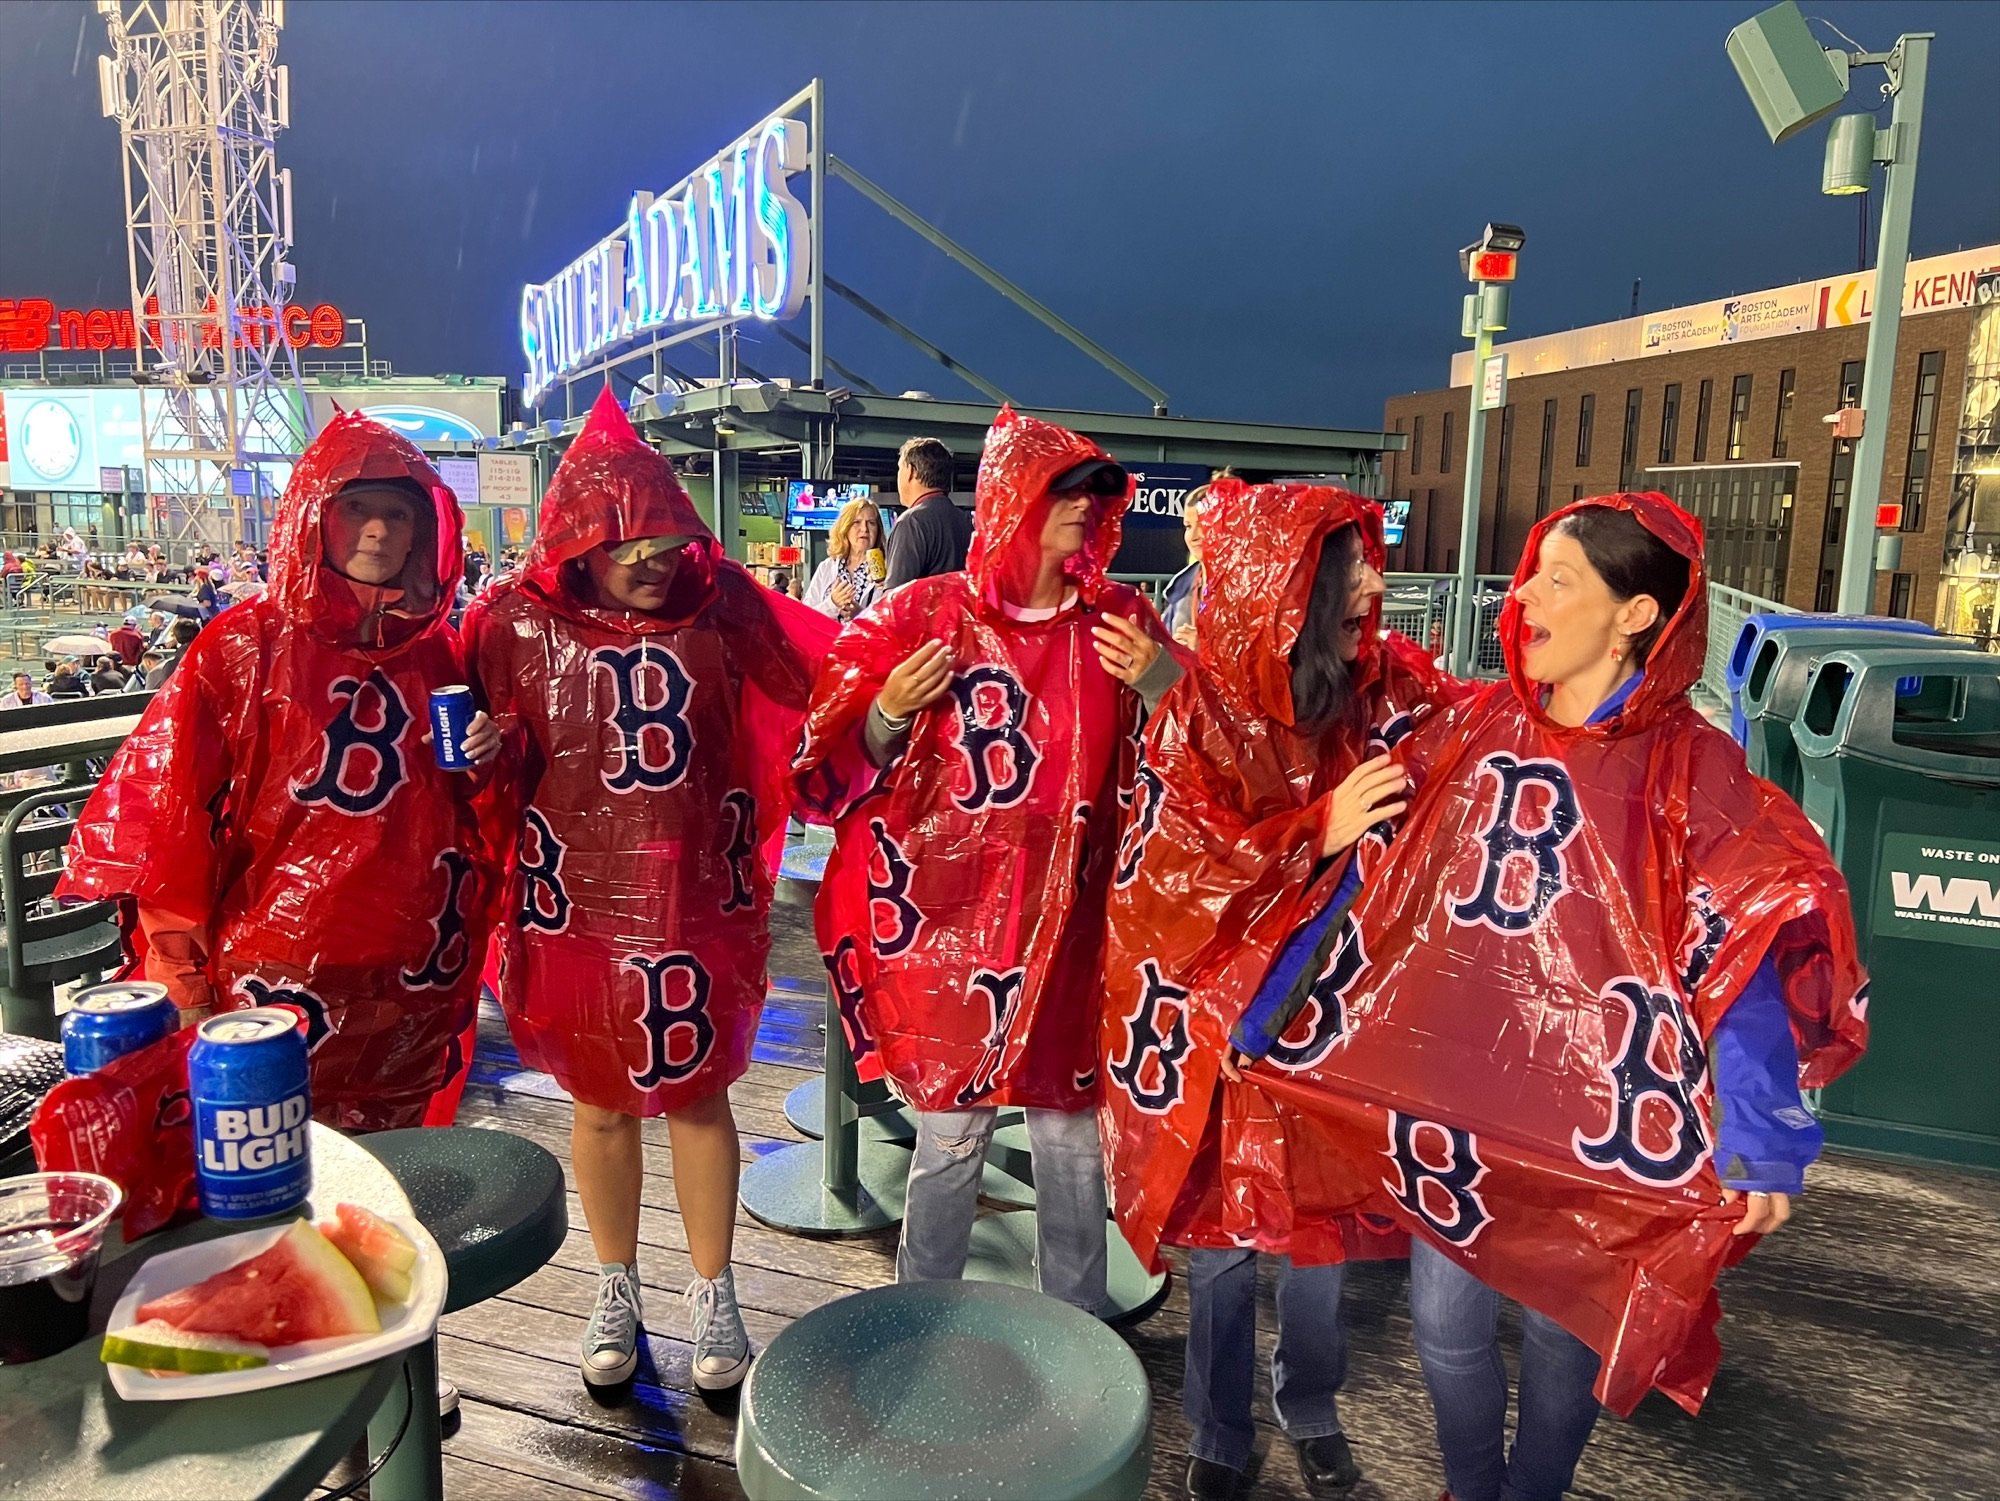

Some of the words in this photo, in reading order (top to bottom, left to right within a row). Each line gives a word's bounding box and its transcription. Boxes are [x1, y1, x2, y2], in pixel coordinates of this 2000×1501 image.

[521, 239, 619, 408] SAMUEL
[622, 117, 797, 334] ADAMS
[1740, 313, 1761, 324] ARTS
[1764, 304, 1810, 320] ACADEMY
[1741, 299, 1778, 314] BOSTON
[59, 309, 139, 350] new
[1661, 320, 1693, 333] BOSTON
[1661, 331, 1679, 342] ARTS
[1681, 324, 1719, 340] ACADEMY
[1739, 319, 1791, 335] FOUNDATION
[1126, 488, 1187, 518] ECK
[438, 705, 451, 738] LIGHT
[586, 642, 698, 795] B
[288, 665, 416, 818] B
[443, 739, 455, 762] BUD
[1444, 750, 1584, 937] B
[1921, 847, 1975, 862] WASTE
[1895, 910, 1937, 921] WASTE
[619, 950, 717, 1092] B
[1572, 975, 1712, 1188] B
[216, 1094, 306, 1140] BUD
[1683, 1187, 1700, 1199] TM
